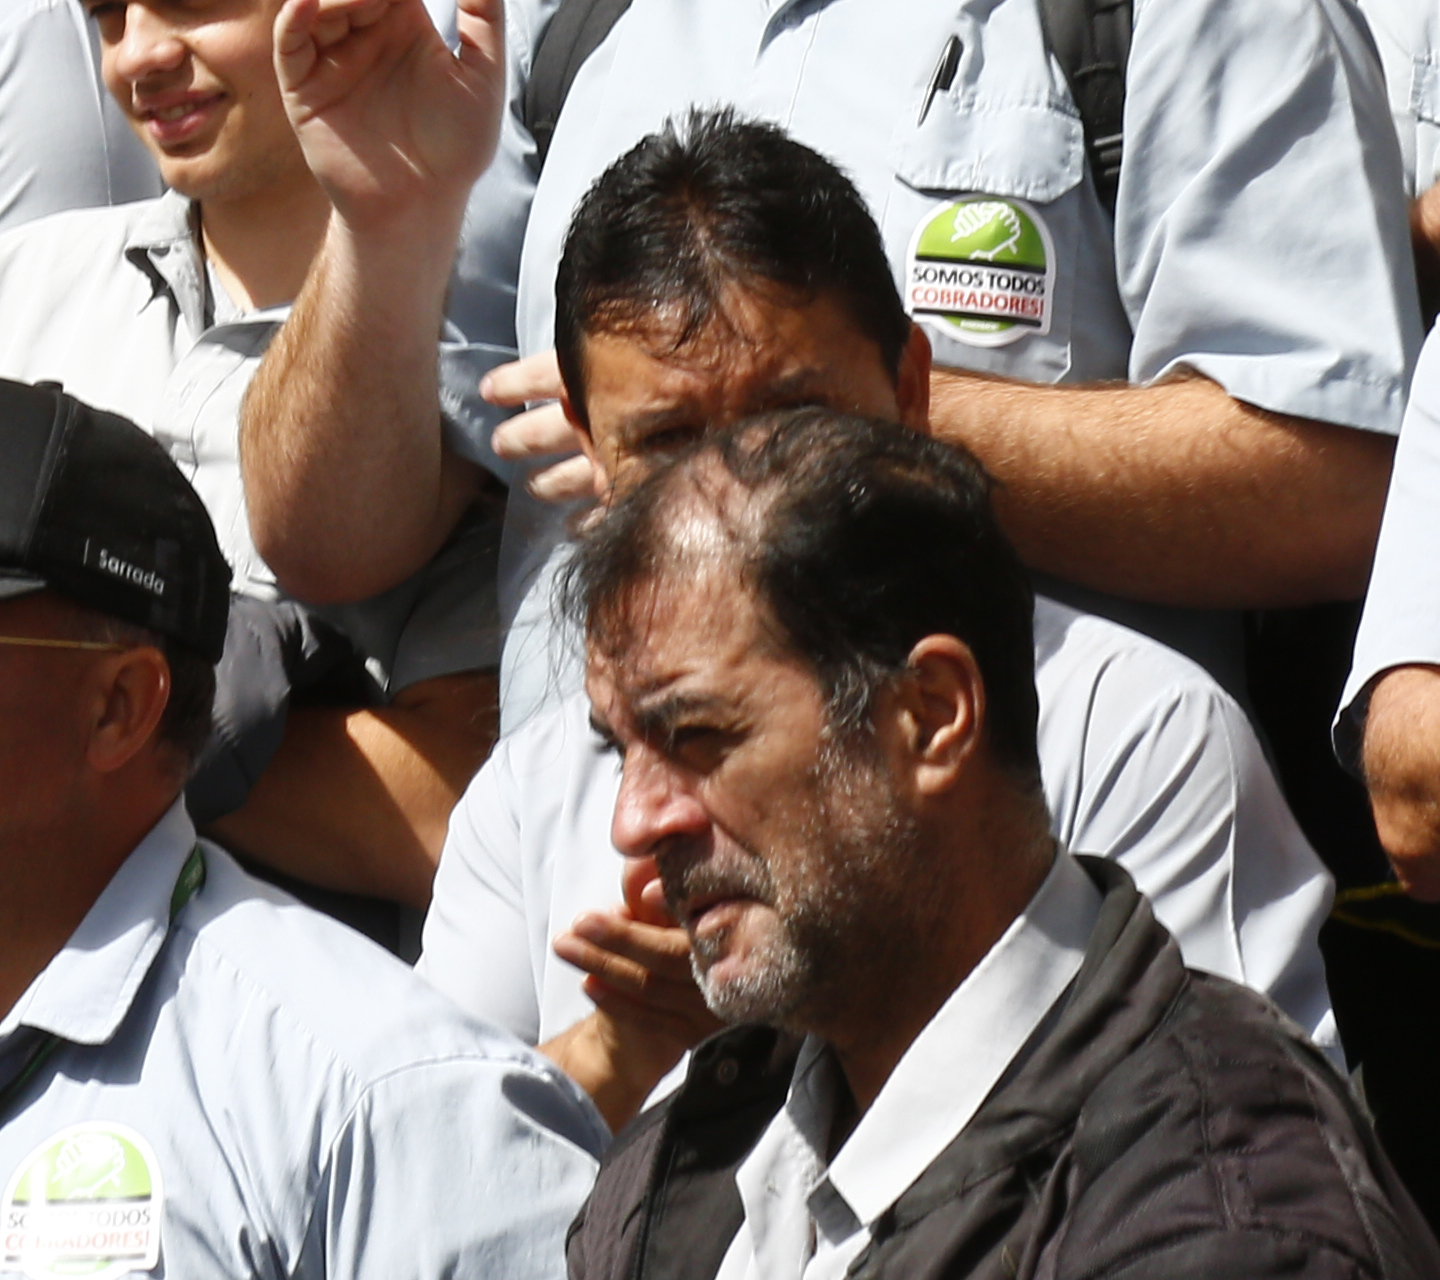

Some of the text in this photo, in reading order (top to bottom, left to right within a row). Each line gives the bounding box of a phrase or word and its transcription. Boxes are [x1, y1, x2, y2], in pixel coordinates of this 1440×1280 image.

[912, 266, 1045, 295] SOMOS TODOS
[911, 287, 1044, 317] COBRADORES!
[99, 548, 165, 595] Sarrada
